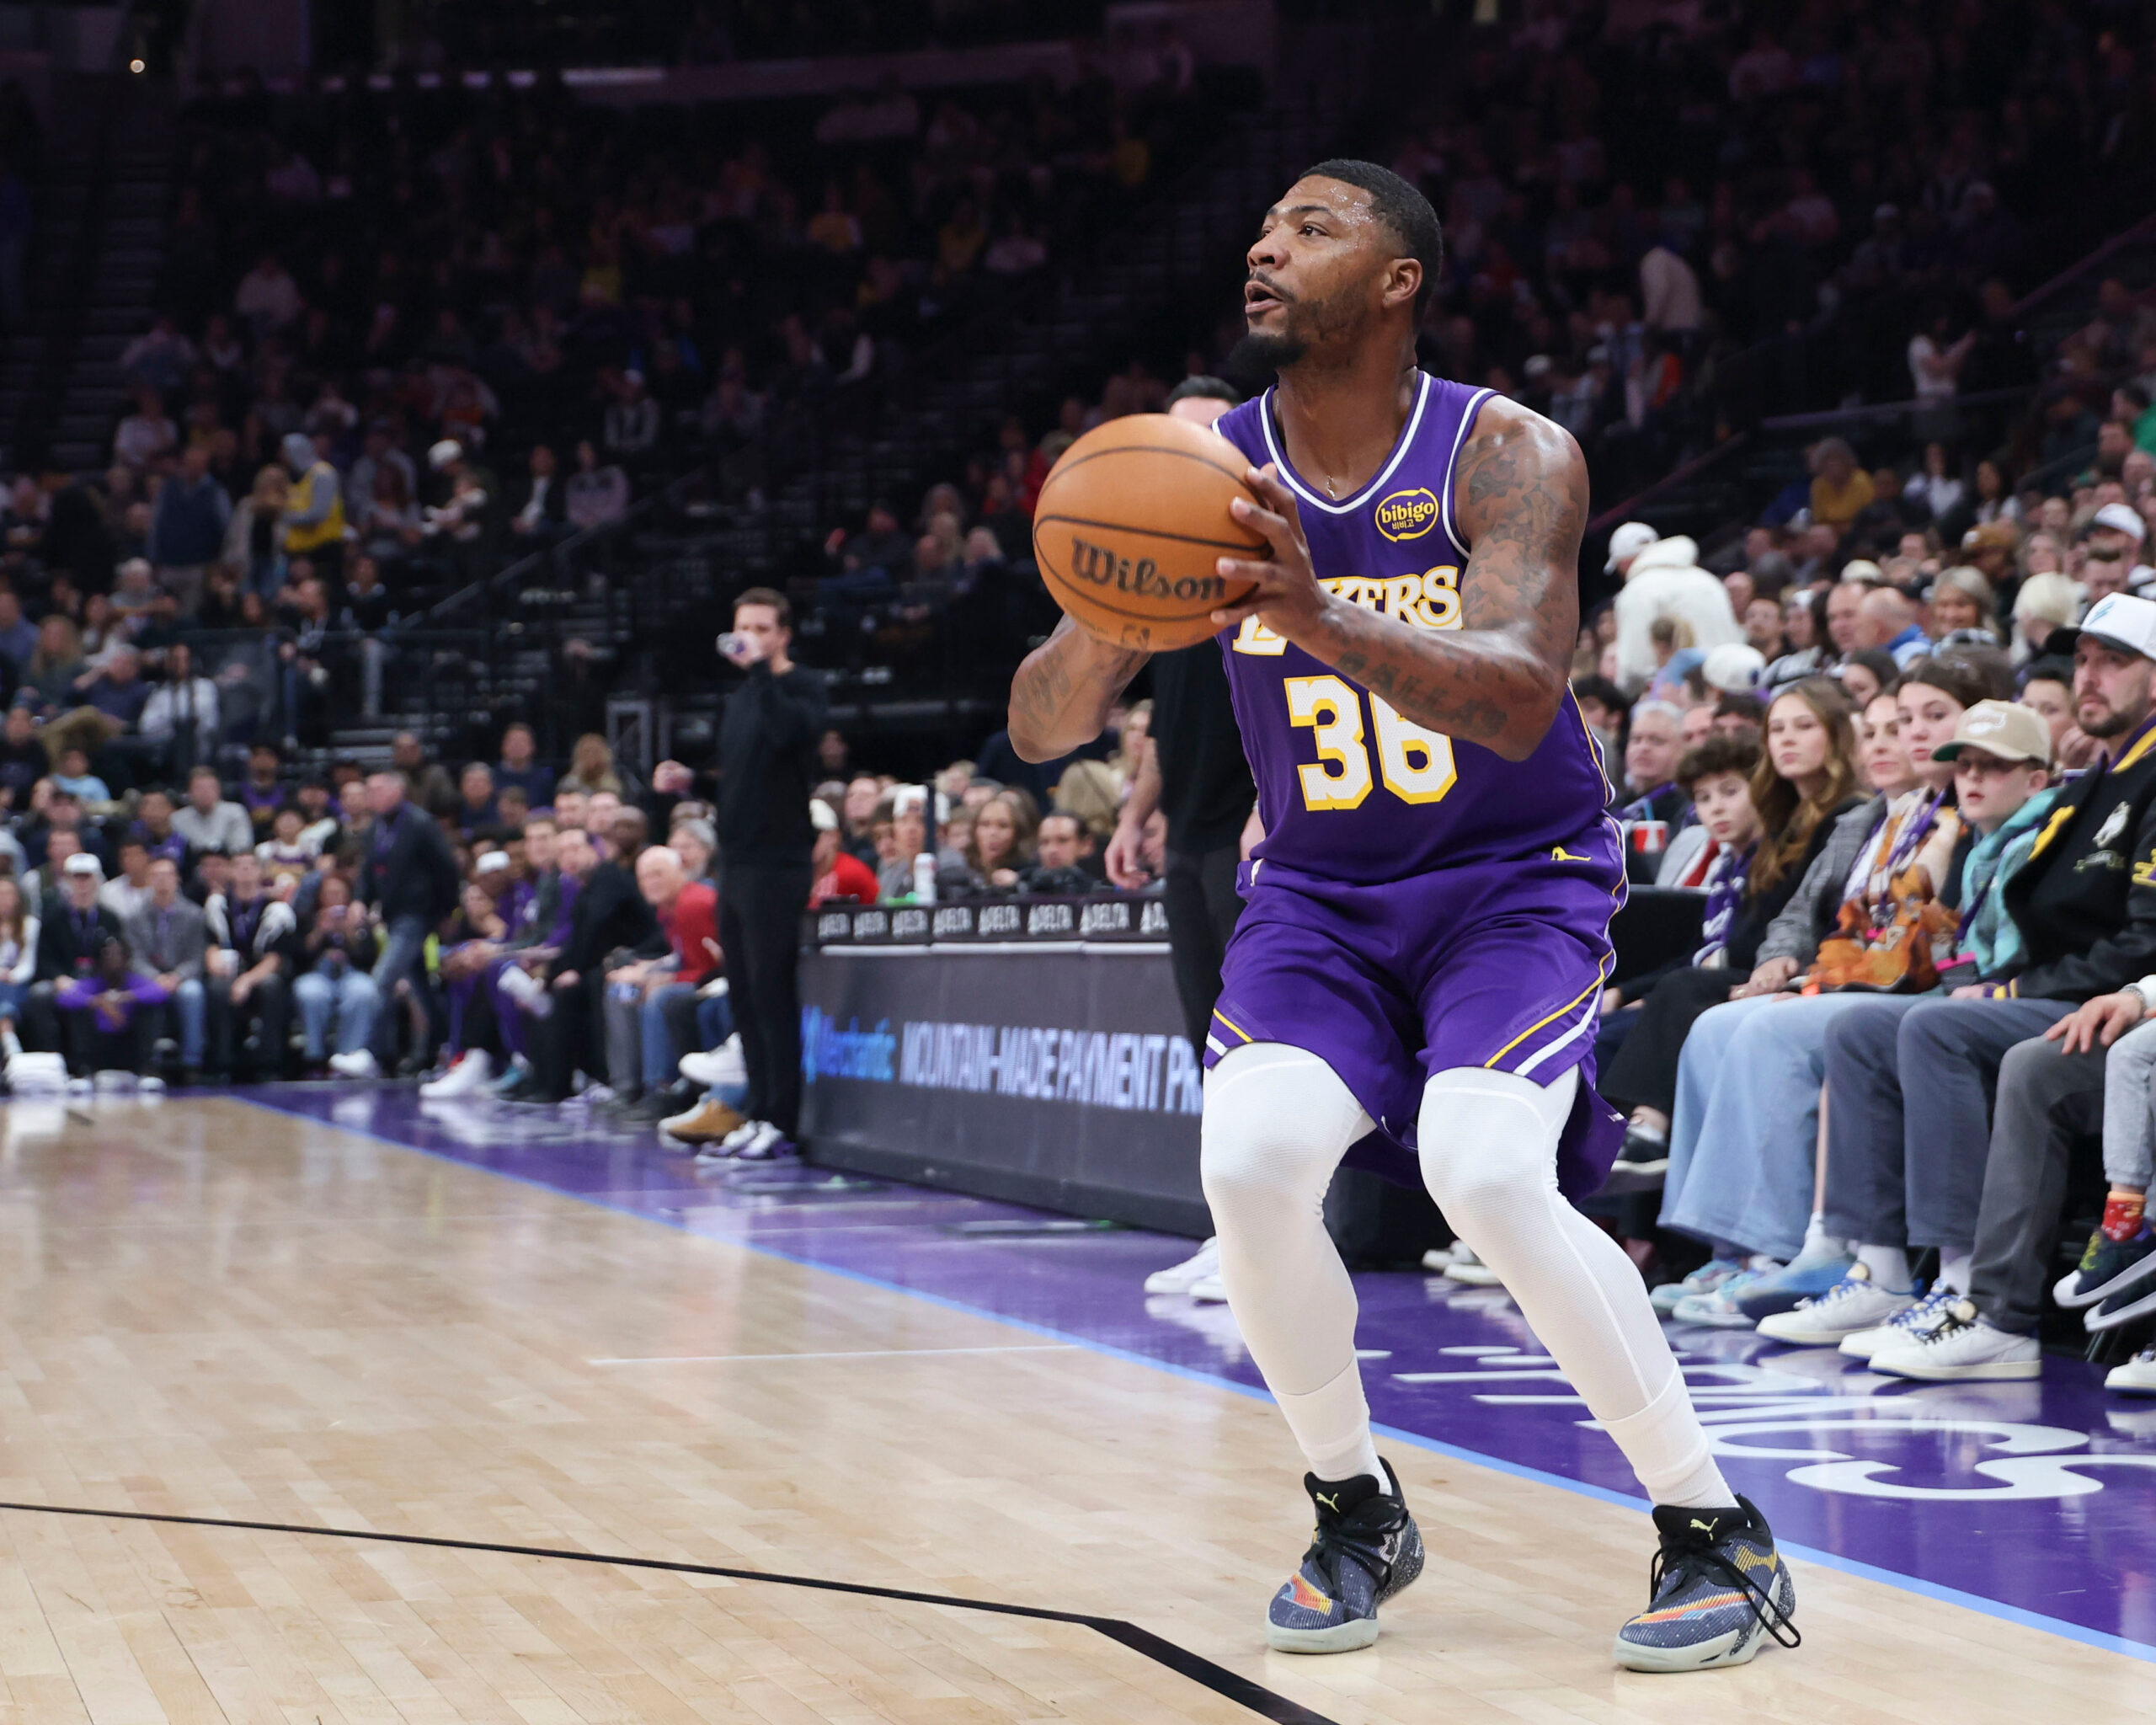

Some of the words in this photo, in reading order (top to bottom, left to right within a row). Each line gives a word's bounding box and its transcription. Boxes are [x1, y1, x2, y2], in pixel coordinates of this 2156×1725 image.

[1381, 501, 1435, 524] bibigo
[1391, 518, 1415, 531] 비비고
[1071, 536, 1227, 601] Wilson
[1232, 565, 1464, 656] LERS
[1283, 675, 1458, 811] 36
[1055, 1028, 1168, 1112] PAYMENT
